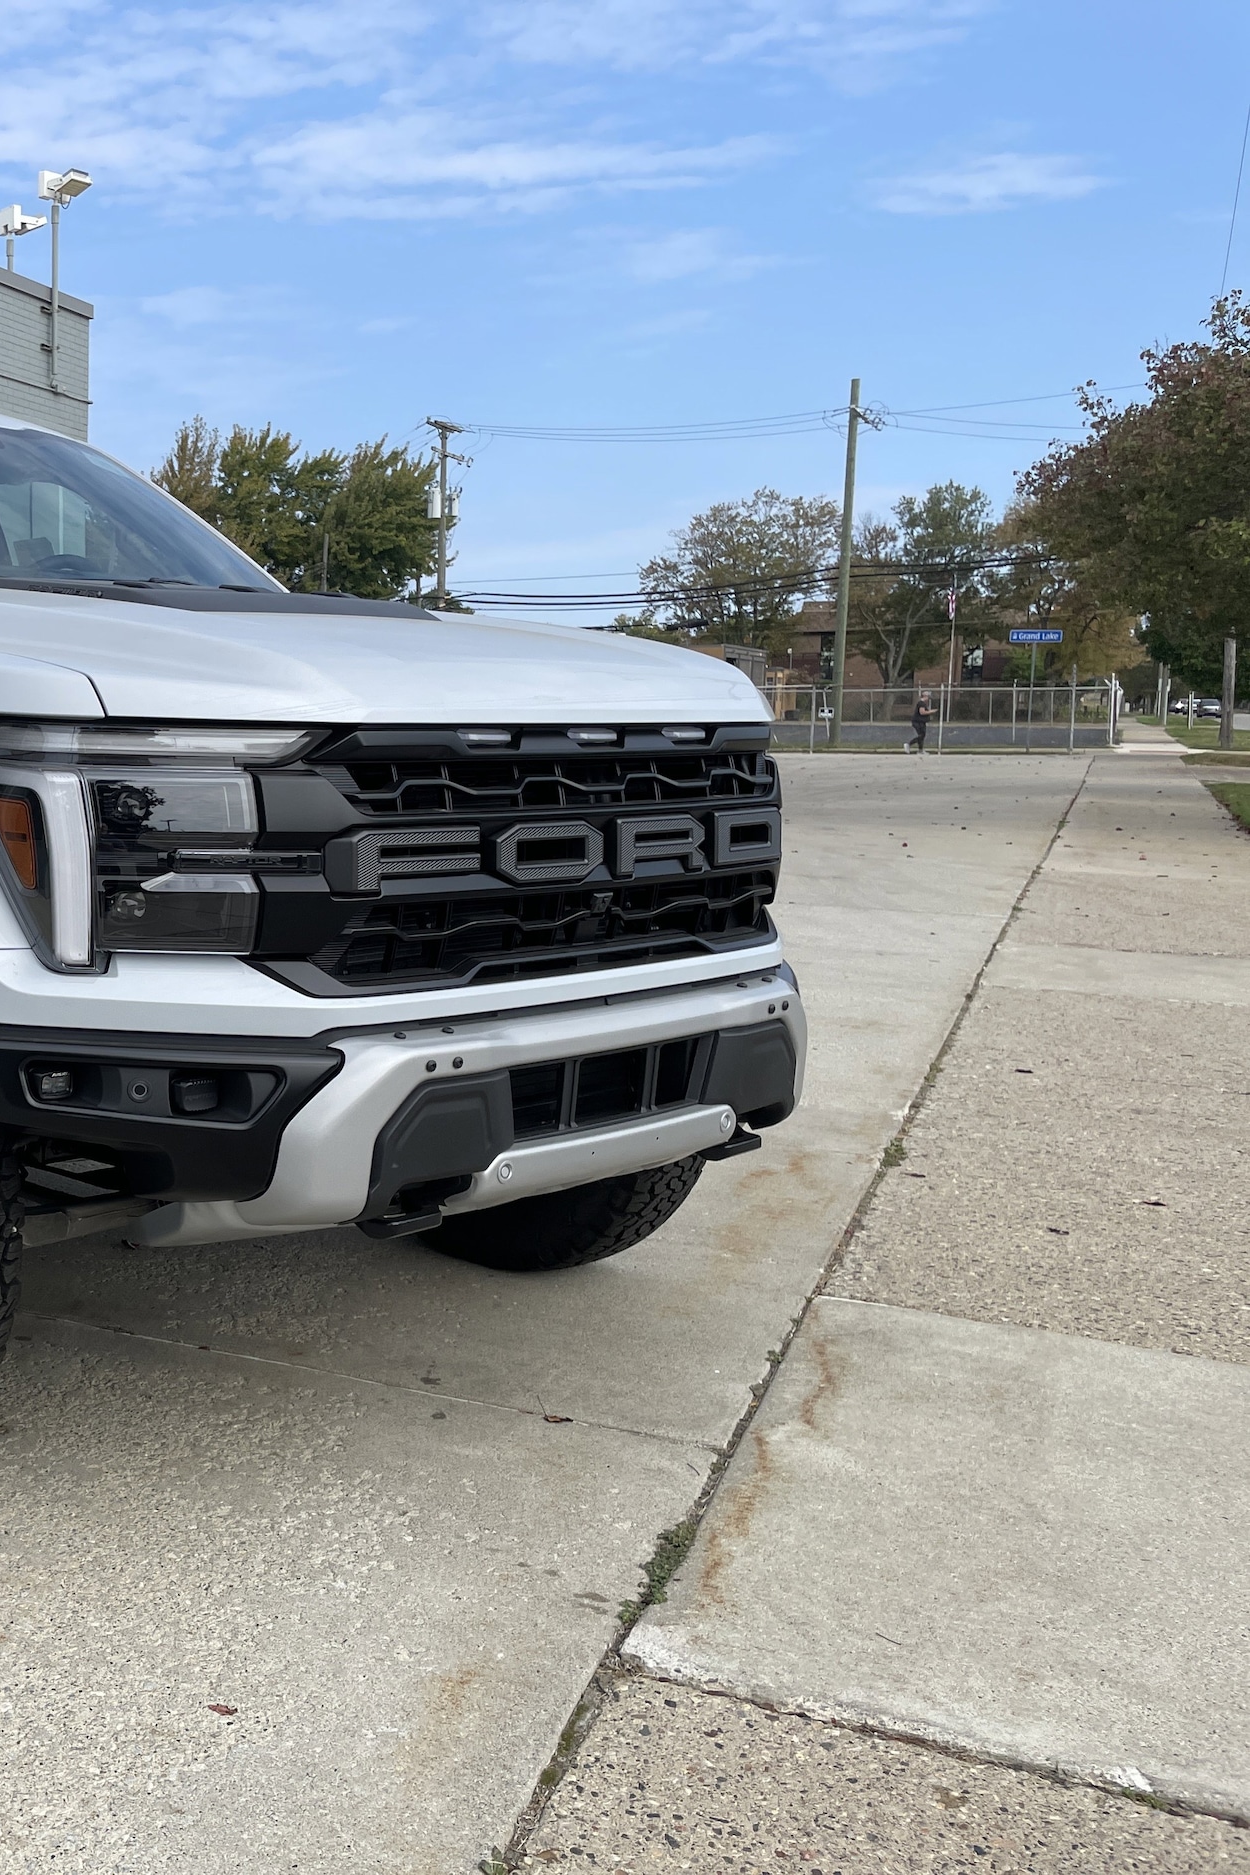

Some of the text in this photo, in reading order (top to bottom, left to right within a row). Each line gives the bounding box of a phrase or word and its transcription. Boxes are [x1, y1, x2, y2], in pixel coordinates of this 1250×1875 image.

[1018, 632, 1059, 640] Grand Lake
[325, 807, 782, 895] FORD
